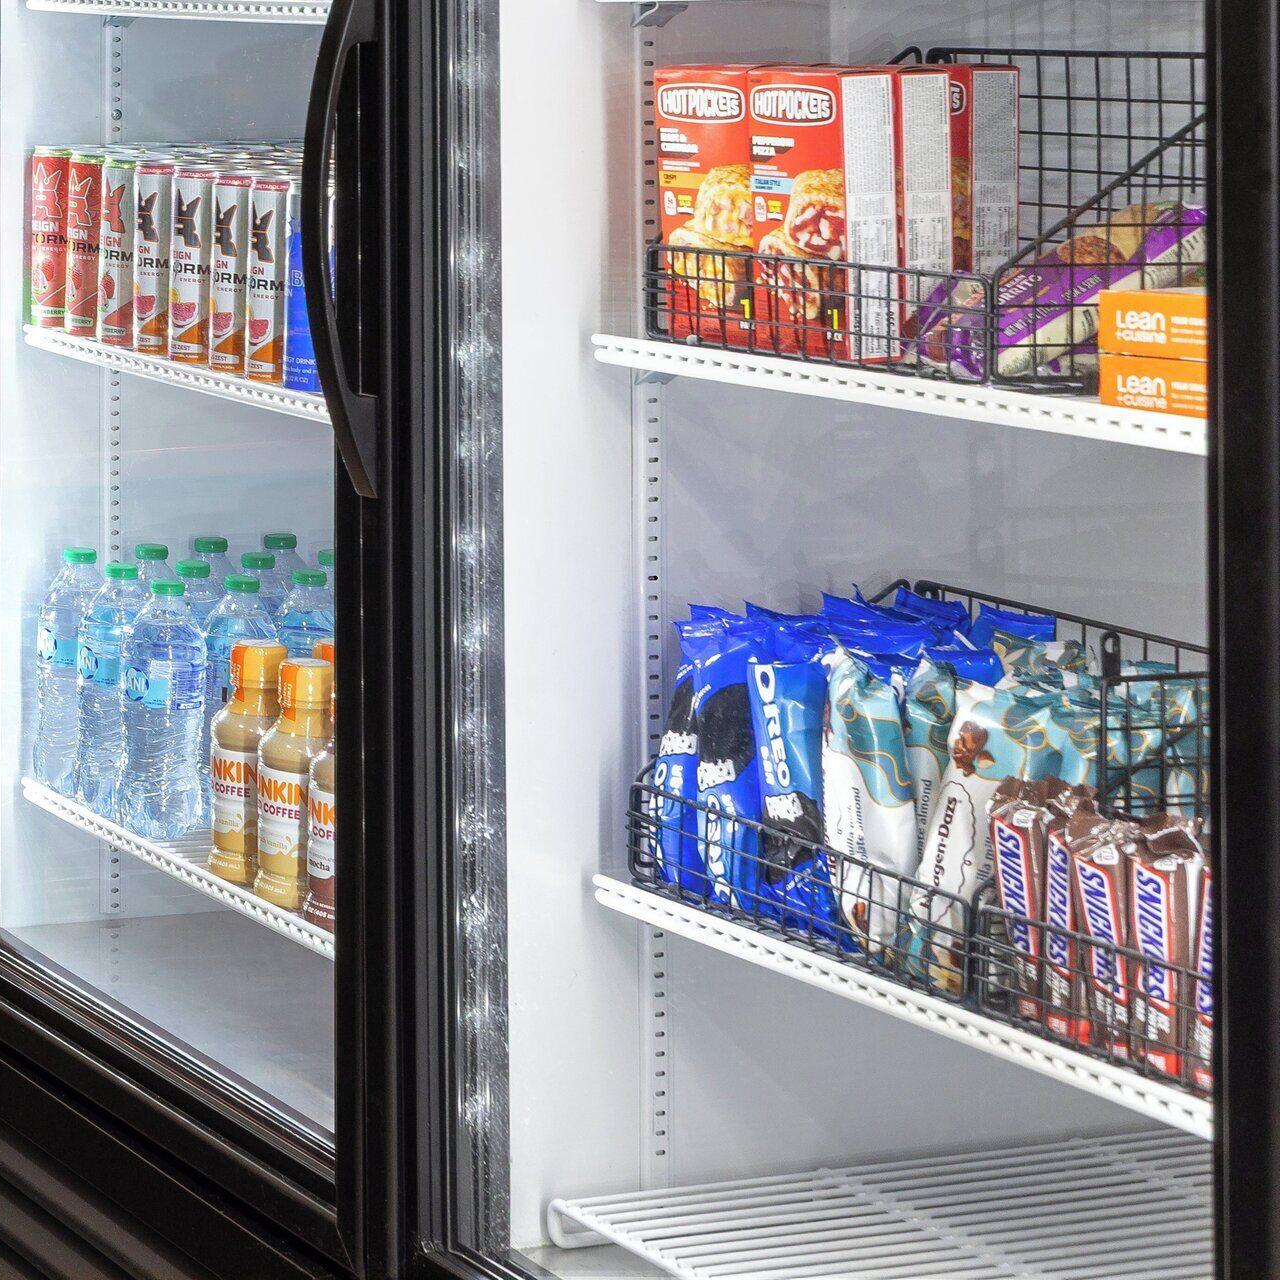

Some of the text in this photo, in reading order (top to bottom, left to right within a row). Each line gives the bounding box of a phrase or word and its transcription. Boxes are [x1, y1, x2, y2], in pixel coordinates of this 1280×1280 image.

[663, 88, 740, 117] HOT POCKETS
[755, 90, 830, 120] HOT POCKETS
[1115, 310, 1166, 330] Lean
[1117, 375, 1166, 396] Lean
[753, 665, 791, 789] OREO
[215, 783, 250, 797] COFFEE
[921, 779, 932, 820] almond
[263, 805, 300, 819] COFFEE
